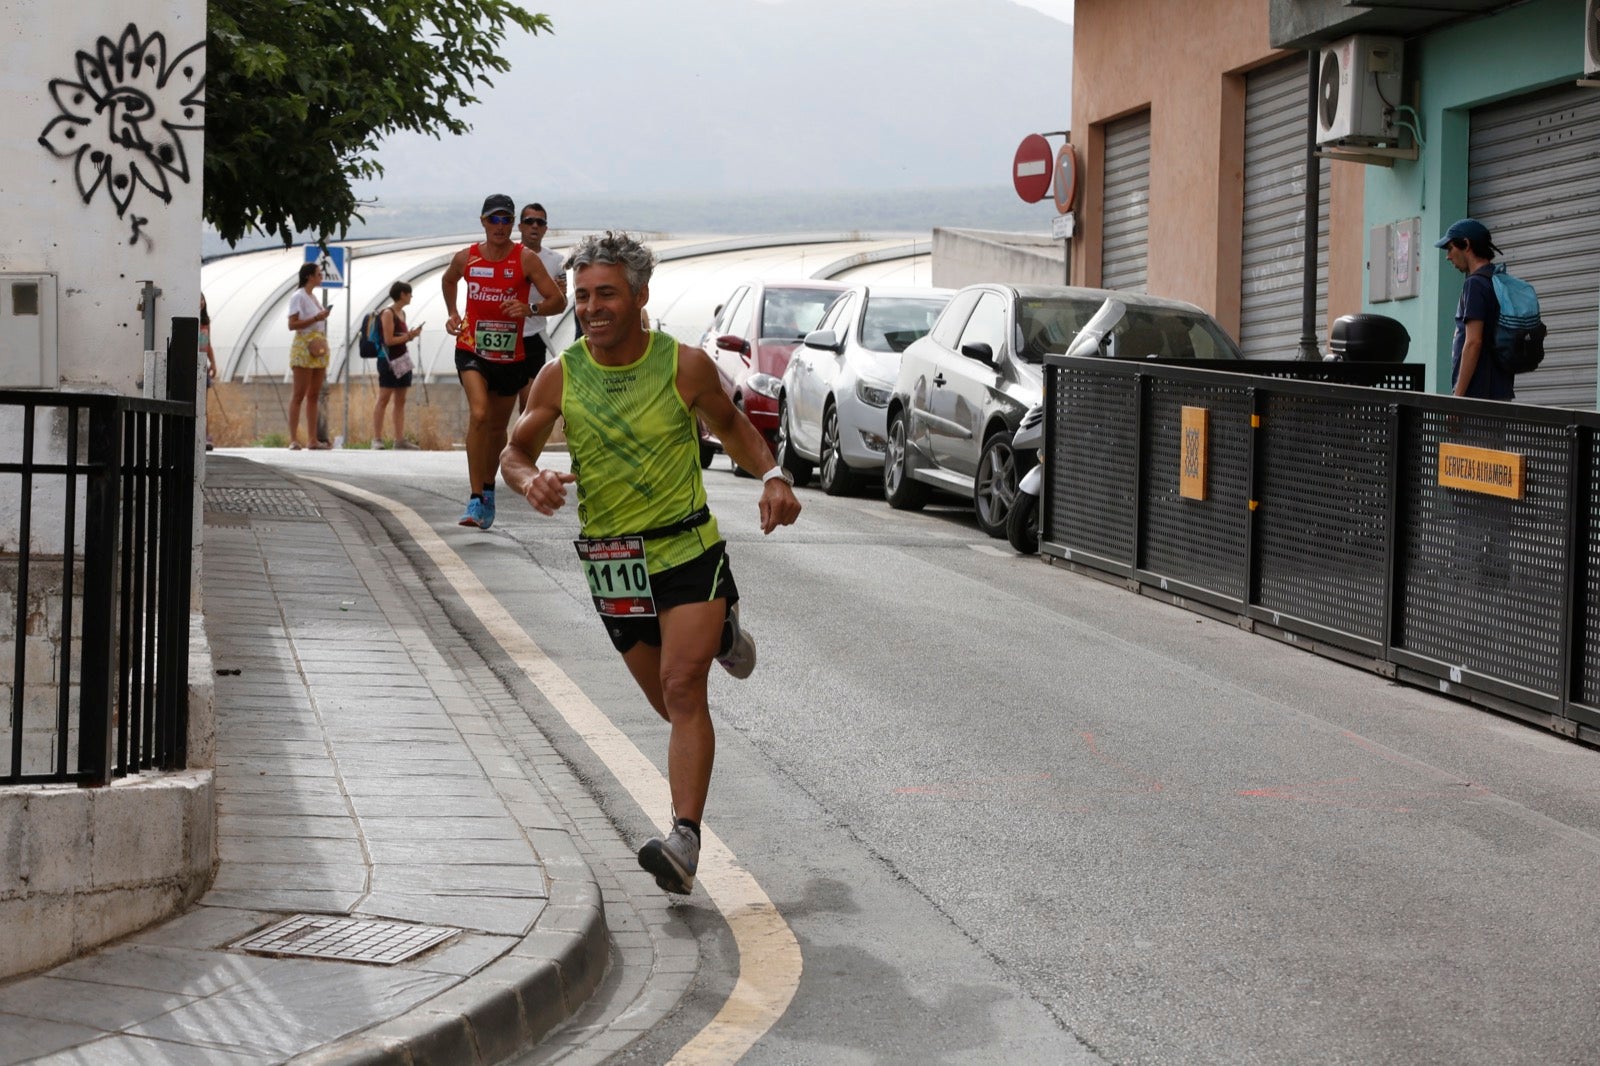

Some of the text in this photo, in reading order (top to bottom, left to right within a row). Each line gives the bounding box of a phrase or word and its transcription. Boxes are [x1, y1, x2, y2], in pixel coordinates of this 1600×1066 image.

[483, 333, 512, 348] 637
[1444, 455, 1513, 488] CERVEZAS ALHAMBRA
[588, 563, 647, 592] 1110
